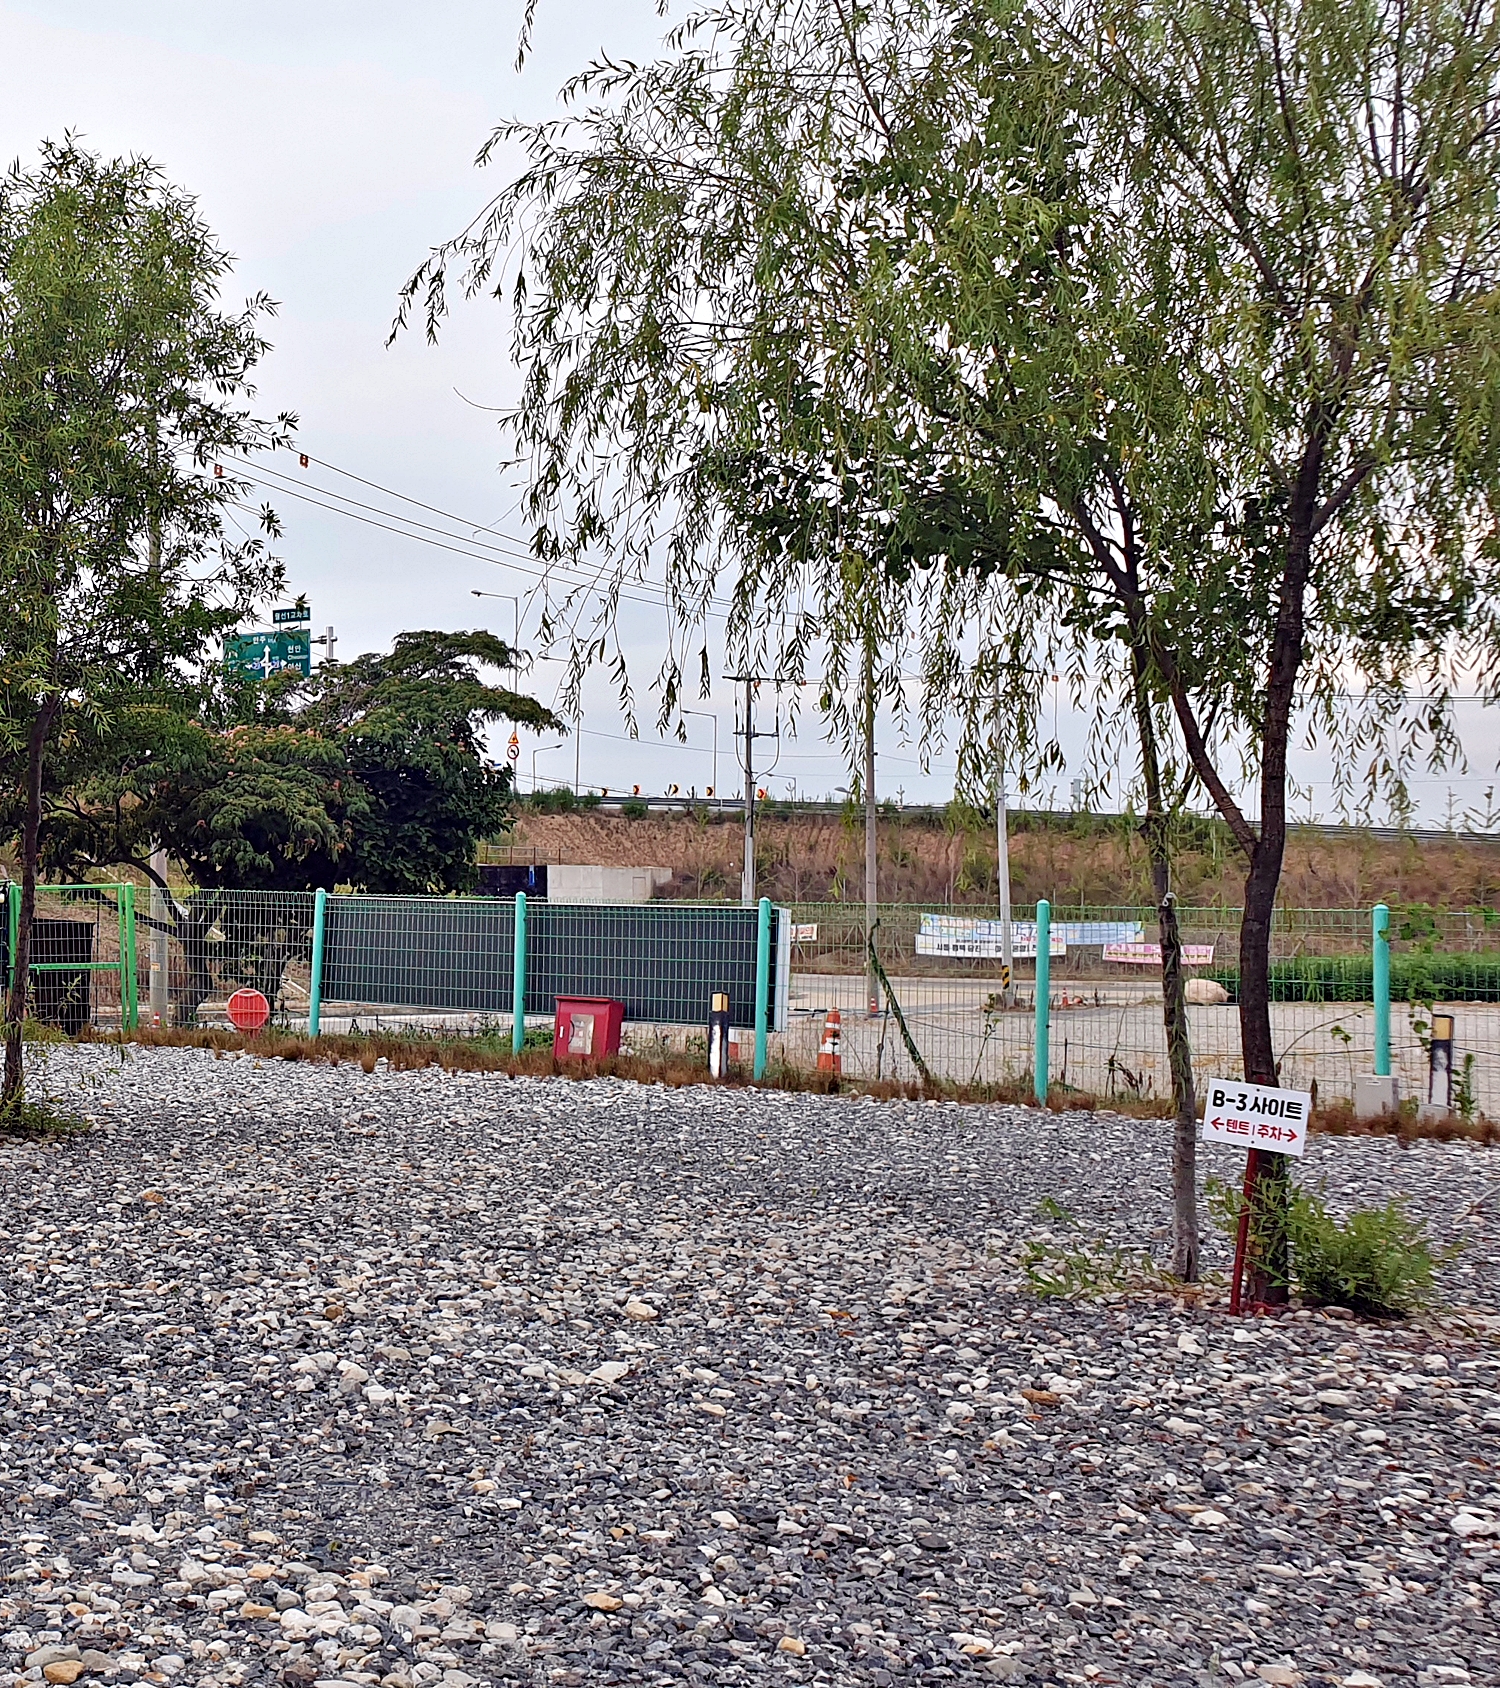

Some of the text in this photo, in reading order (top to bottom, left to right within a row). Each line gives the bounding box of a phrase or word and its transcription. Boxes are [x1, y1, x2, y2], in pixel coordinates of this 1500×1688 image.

[1212, 1089, 1303, 1120] B-3 사이트
[1226, 1119, 1283, 1141] 텐트 주차
